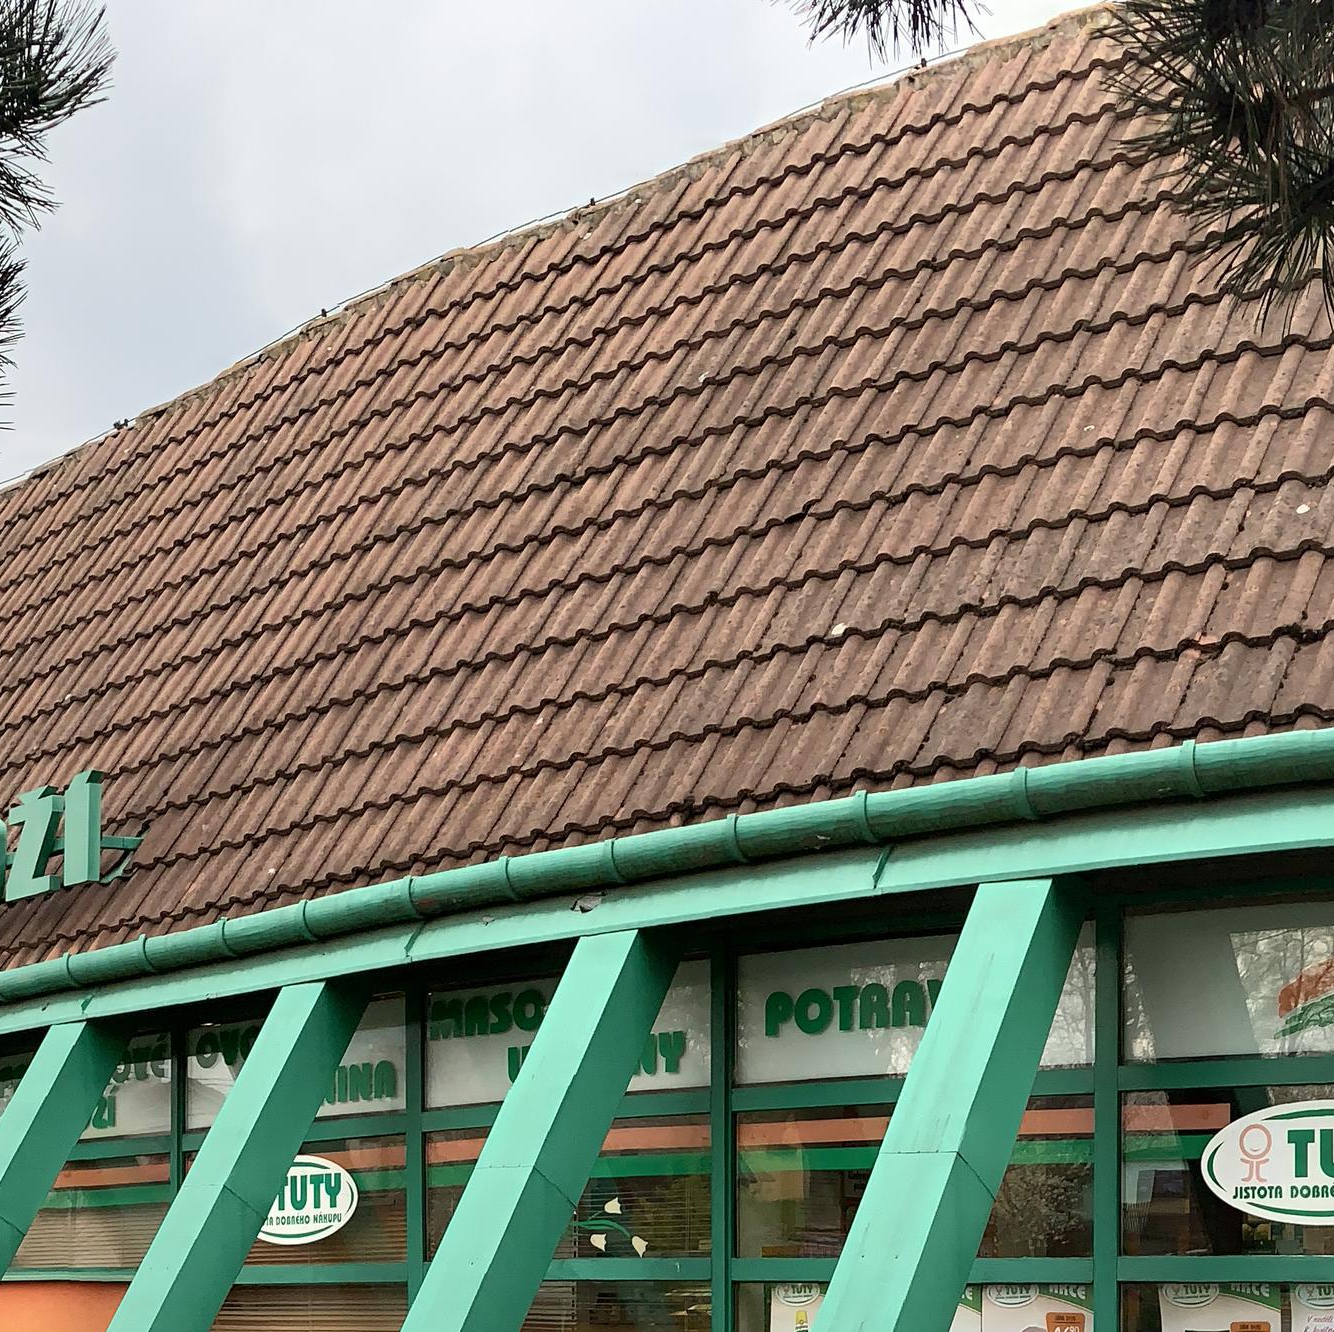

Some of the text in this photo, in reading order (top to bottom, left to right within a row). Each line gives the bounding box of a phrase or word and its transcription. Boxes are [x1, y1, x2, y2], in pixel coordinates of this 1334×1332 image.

[1233, 1185, 1283, 1199] JISTOTA
[276, 1213, 310, 1226] DOBRÉHO
[313, 1211, 342, 1224] NÁKUPU
